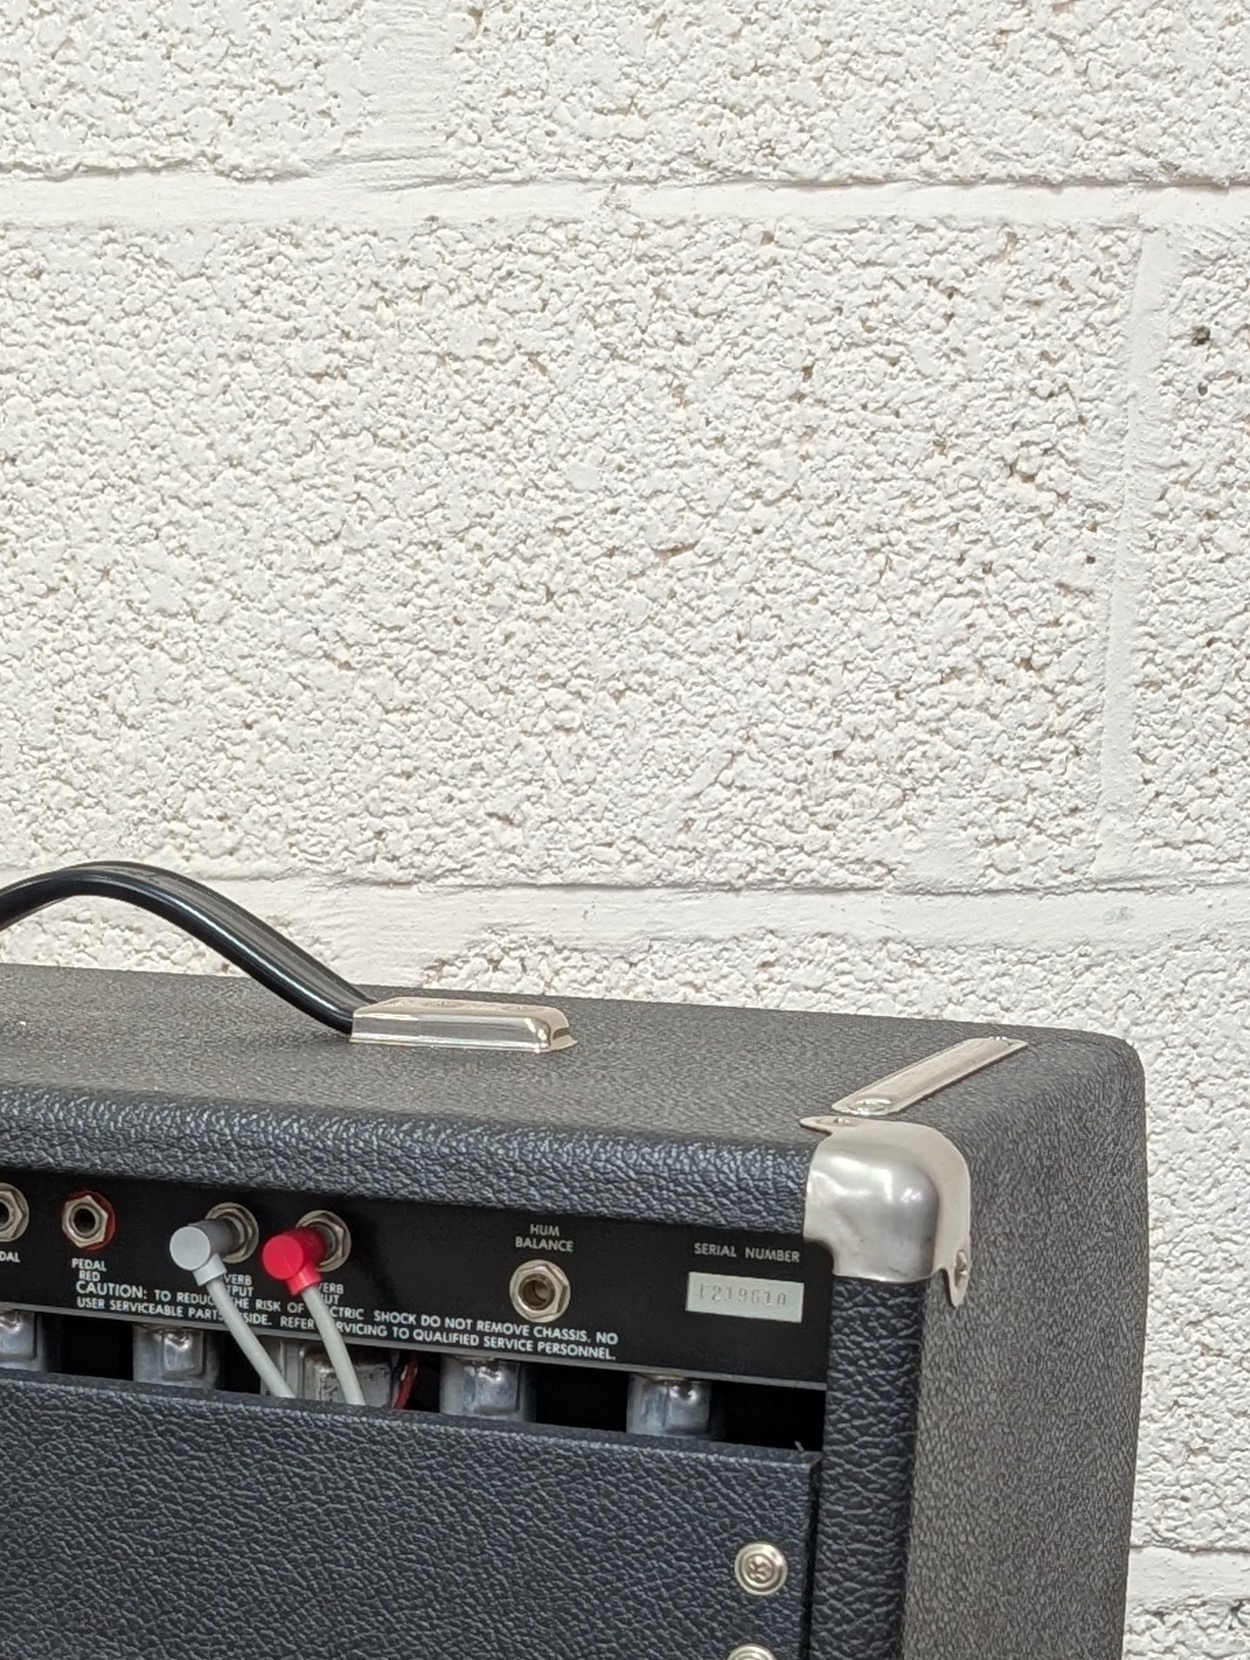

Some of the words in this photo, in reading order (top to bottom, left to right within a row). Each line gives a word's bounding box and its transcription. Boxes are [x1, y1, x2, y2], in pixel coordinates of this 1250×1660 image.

[530, 1223, 560, 1237] HUM
[515, 1235, 574, 1253] BALANCE
[694, 1242, 737, 1258] SERIAL
[745, 1247, 800, 1263] NUMBER
[71, 1258, 107, 1272] PEDAL
[79, 1270, 100, 1282] RED
[223, 1273, 252, 1286] VERB
[227, 1286, 253, 1297] TPUT
[76, 1281, 147, 1300] CAUTION:
[154, 1289, 171, 1302] TO
[176, 1291, 216, 1306] REDUC
[255, 1299, 281, 1312] RISK
[287, 1302, 304, 1314] OF
[330, 1306, 364, 1321] CTRIC
[373, 1310, 416, 1326] SHOCK
[420, 1314, 441, 1328] DO
[444, 1316, 473, 1331] NOT
[476, 1320, 530, 1337] REMOVE
[595, 1331, 619, 1345] NO
[77, 1296, 105, 1310] USER
[110, 1299, 184, 1318] SERVICEABLE
[242, 1313, 273, 1326] SIDE.
[280, 1315, 315, 1330] REFER
[336, 1321, 388, 1337] RVICING
[392, 1326, 410, 1340] TO
[412, 1328, 480, 1346] QUALIFIED
[483, 1335, 534, 1353] SERVICE
[537, 1341, 617, 1361] PERSONNEL.
